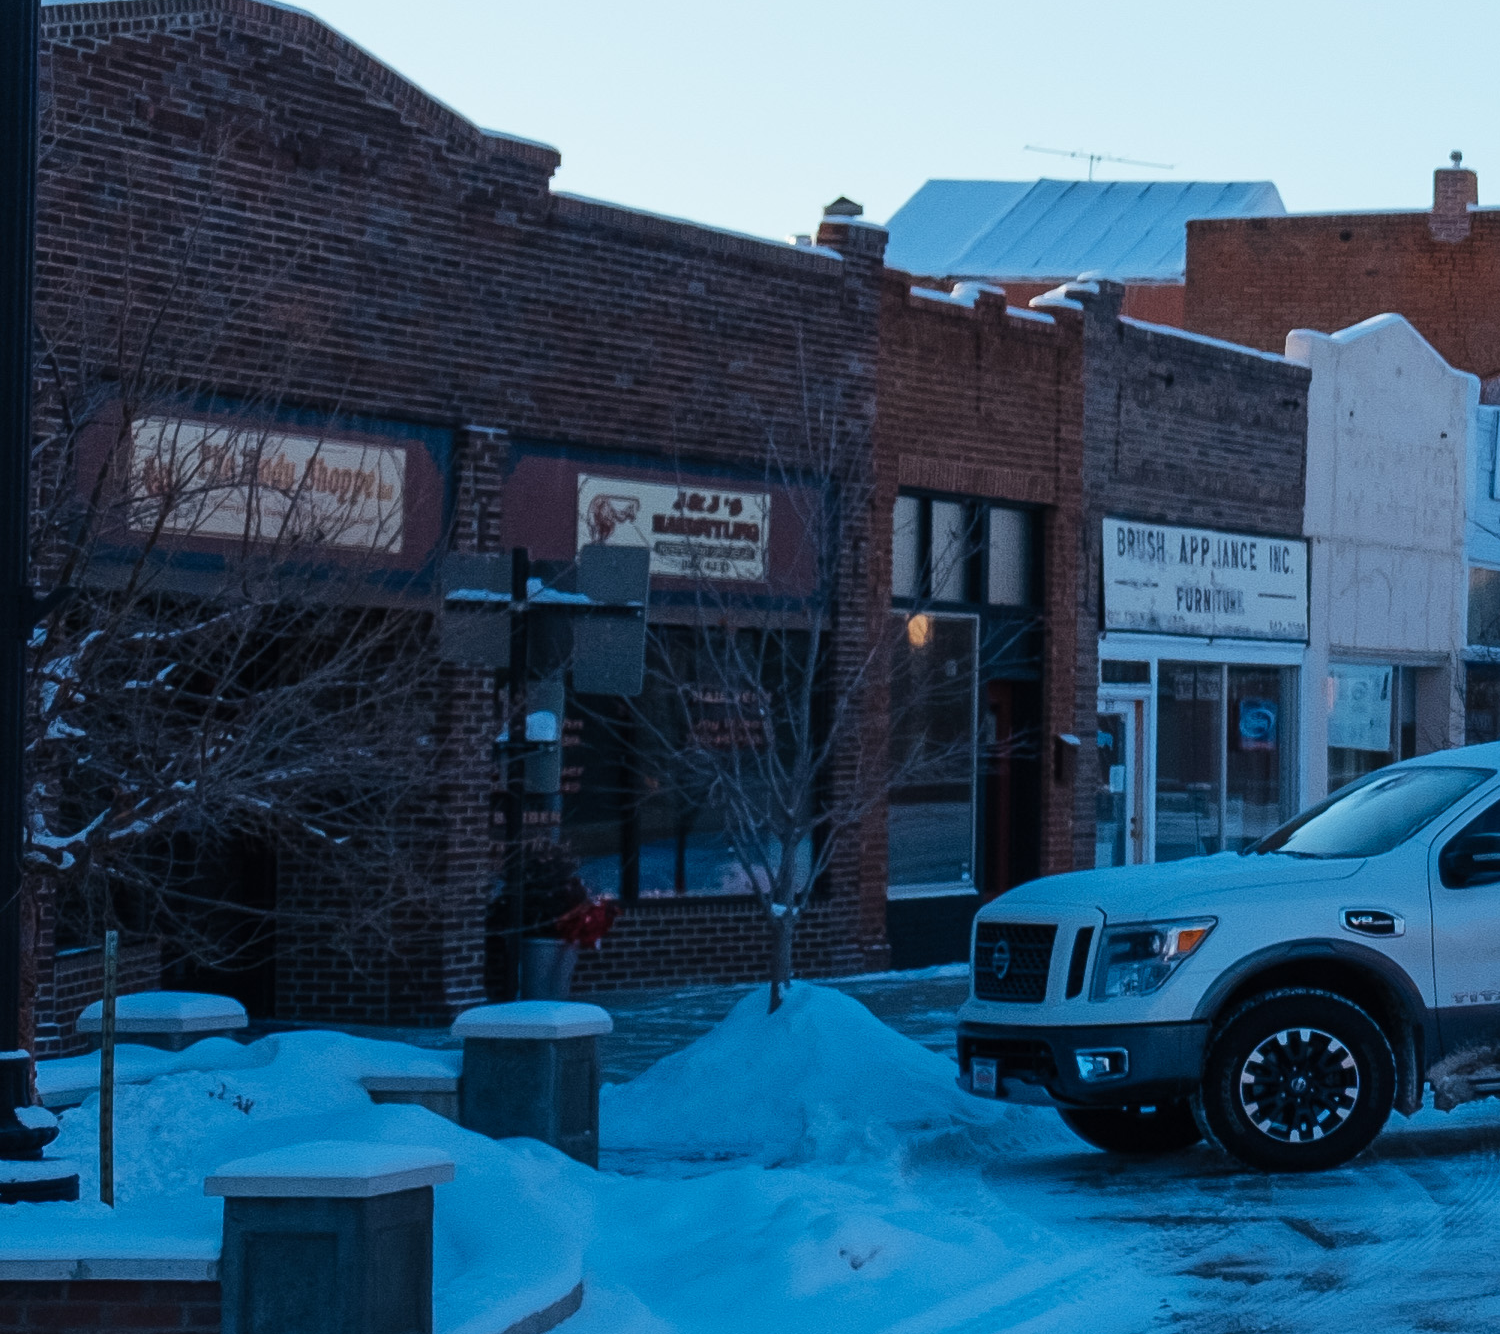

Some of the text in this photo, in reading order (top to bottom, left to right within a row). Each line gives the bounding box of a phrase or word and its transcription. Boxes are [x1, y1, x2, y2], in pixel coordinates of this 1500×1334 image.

[1116, 527, 1165, 563] BRUSH
[1269, 545, 1294, 575] INC.
[1177, 586, 1245, 614] FURNITURE
